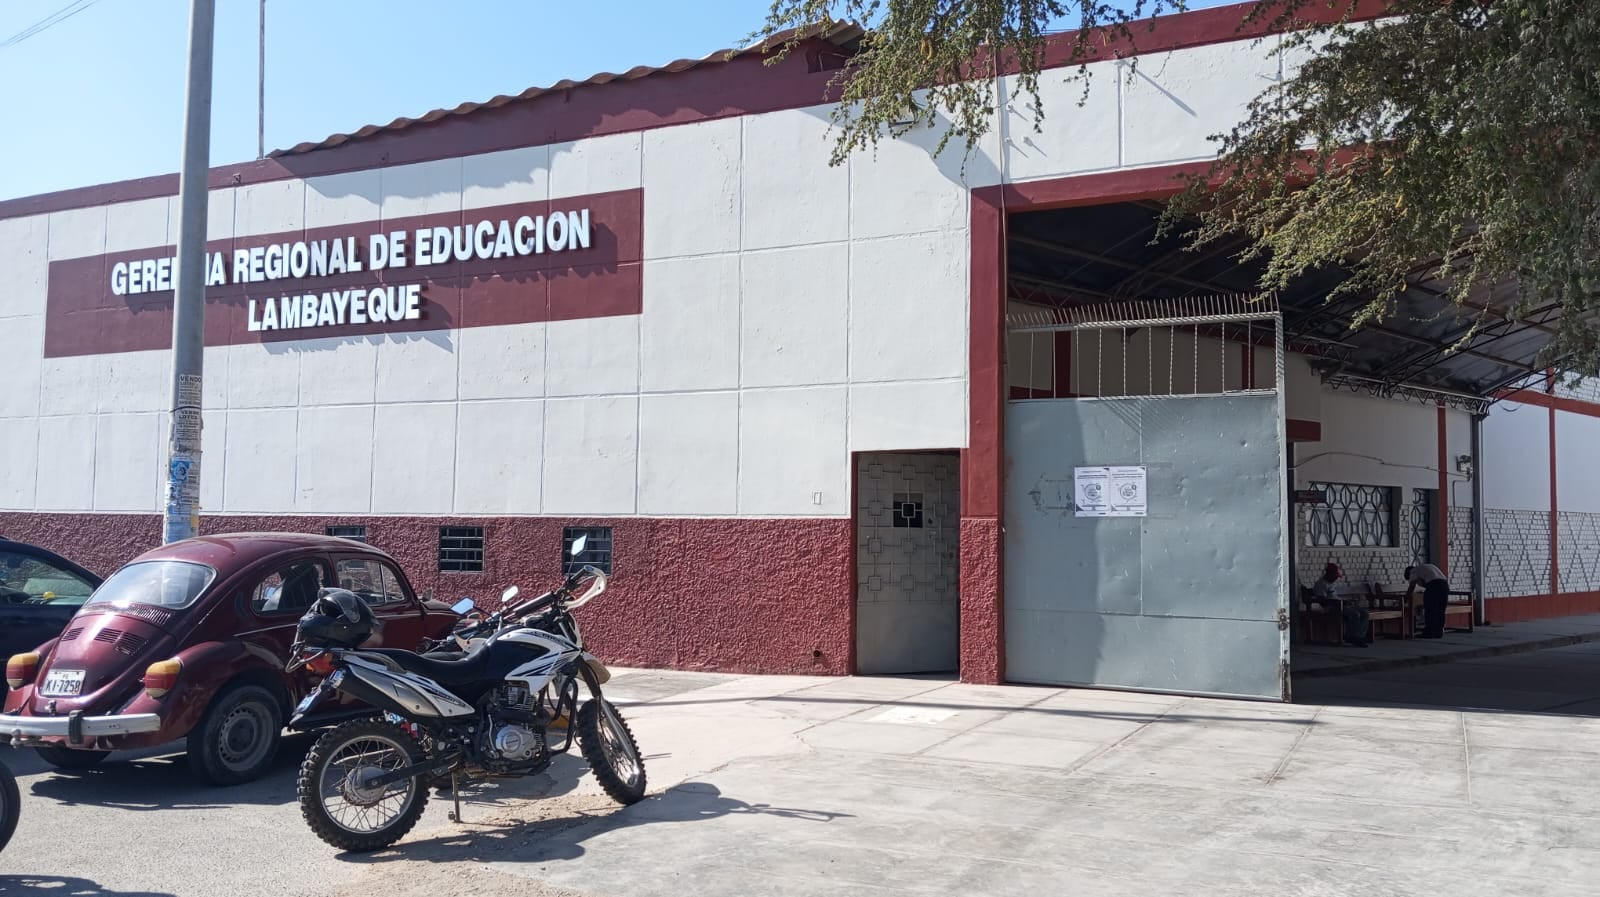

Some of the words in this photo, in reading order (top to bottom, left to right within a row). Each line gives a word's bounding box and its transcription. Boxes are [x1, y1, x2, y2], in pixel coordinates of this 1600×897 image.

[111, 251, 226, 296] GEREIA
[232, 236, 362, 284] REGIONAL
[369, 230, 408, 271] DE
[414, 208, 591, 266] EDUCACION
[247, 284, 421, 332] LAMBAYEQUE
[45, 679, 81, 692] KI-7258
